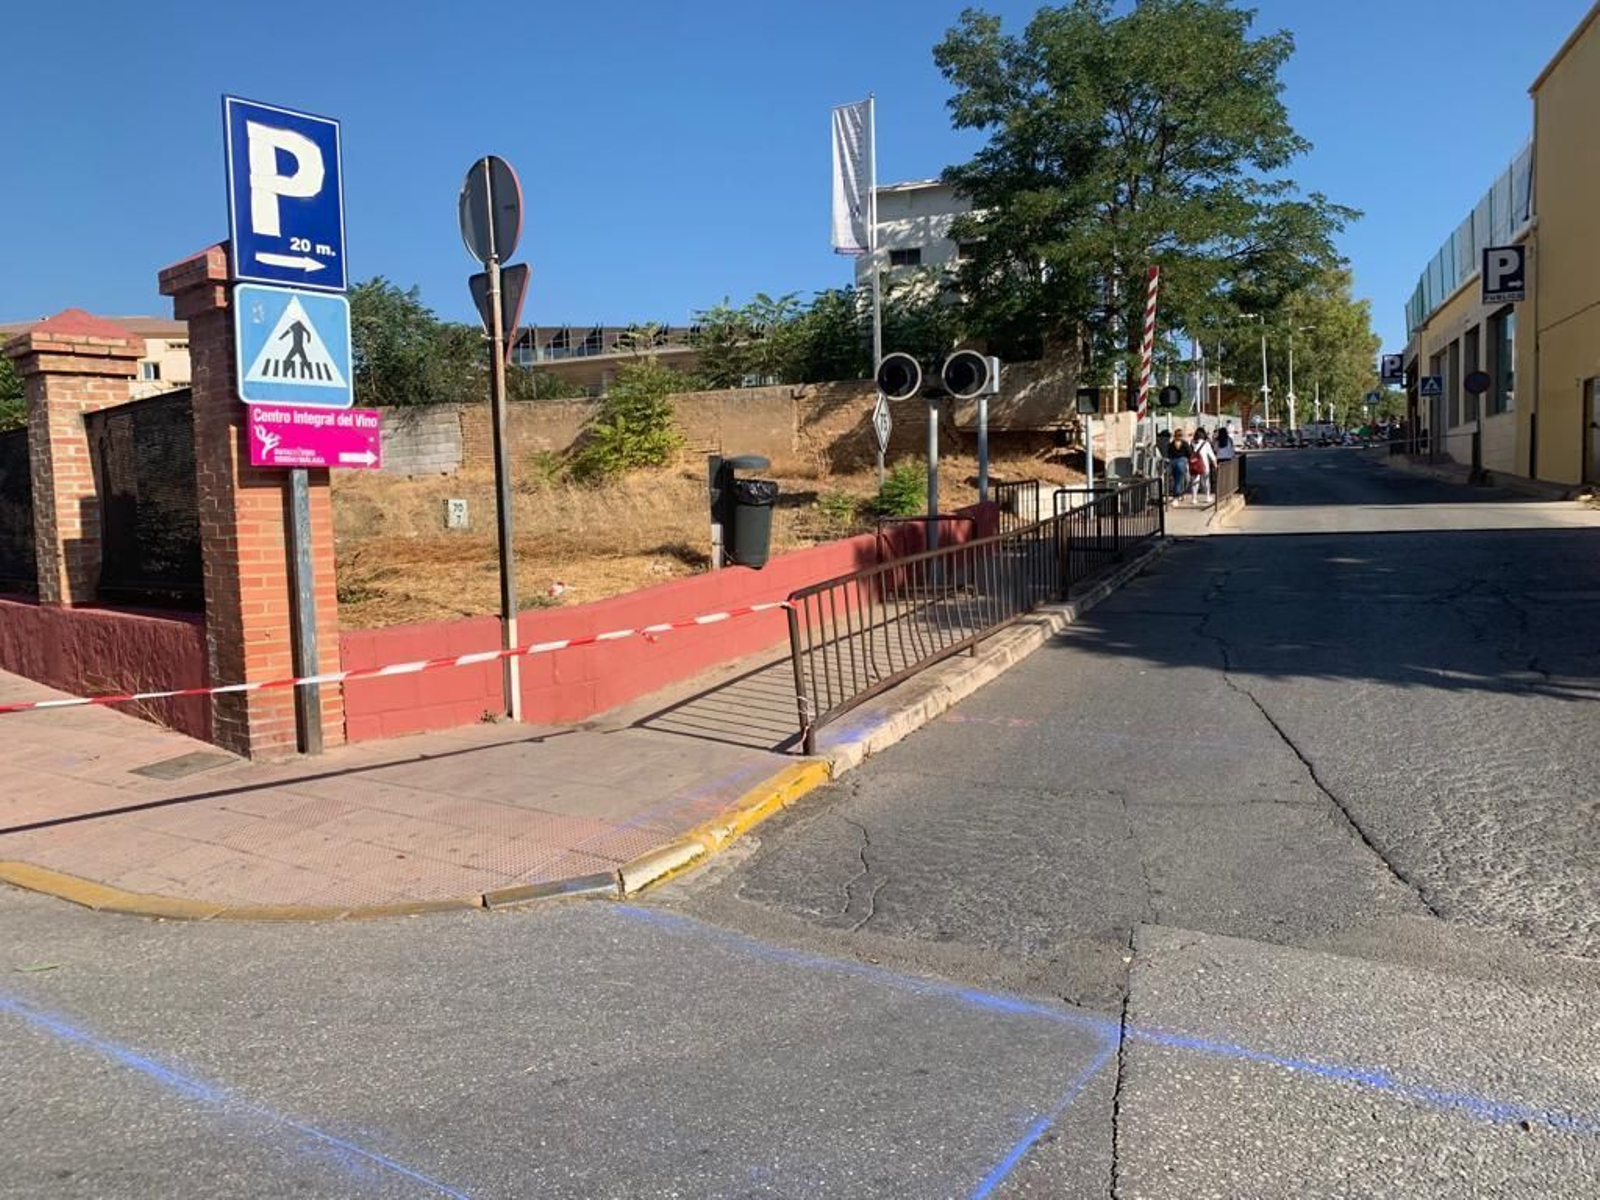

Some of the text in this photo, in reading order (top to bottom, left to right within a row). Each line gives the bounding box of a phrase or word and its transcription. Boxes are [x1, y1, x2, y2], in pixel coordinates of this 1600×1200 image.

[246, 120, 325, 238] P
[290, 237, 337, 257] 20 m.
[1487, 249, 1520, 291] P
[1383, 356, 1401, 377] P
[253, 408, 378, 428] Centro Integral del Vino
